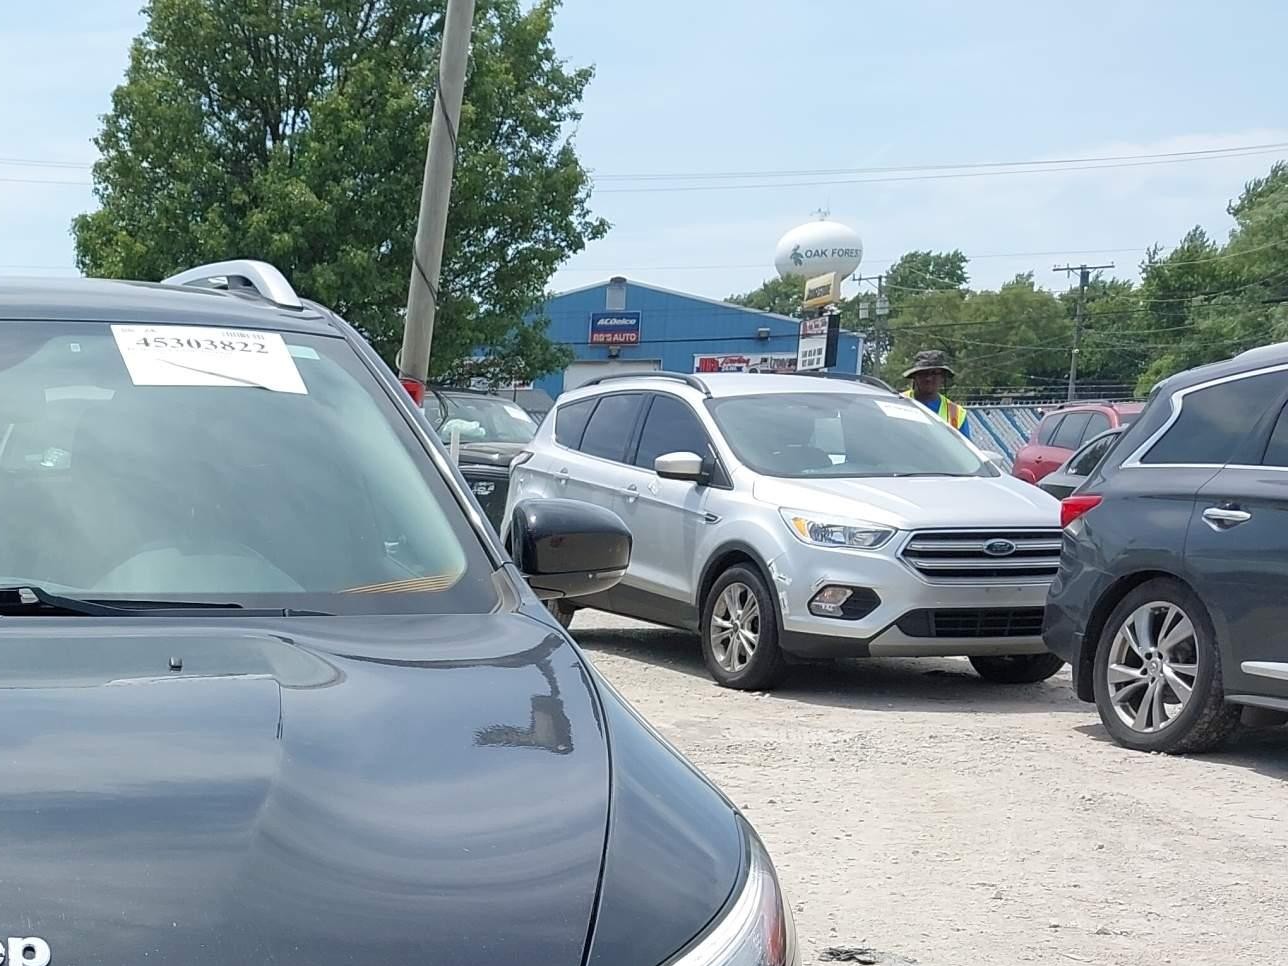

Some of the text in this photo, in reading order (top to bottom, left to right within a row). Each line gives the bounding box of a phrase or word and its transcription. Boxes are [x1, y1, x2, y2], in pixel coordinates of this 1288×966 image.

[805, 248, 862, 258] OAK FOREST
[613, 333, 636, 342] AUTO
[136, 337, 269, 354] 45303822
